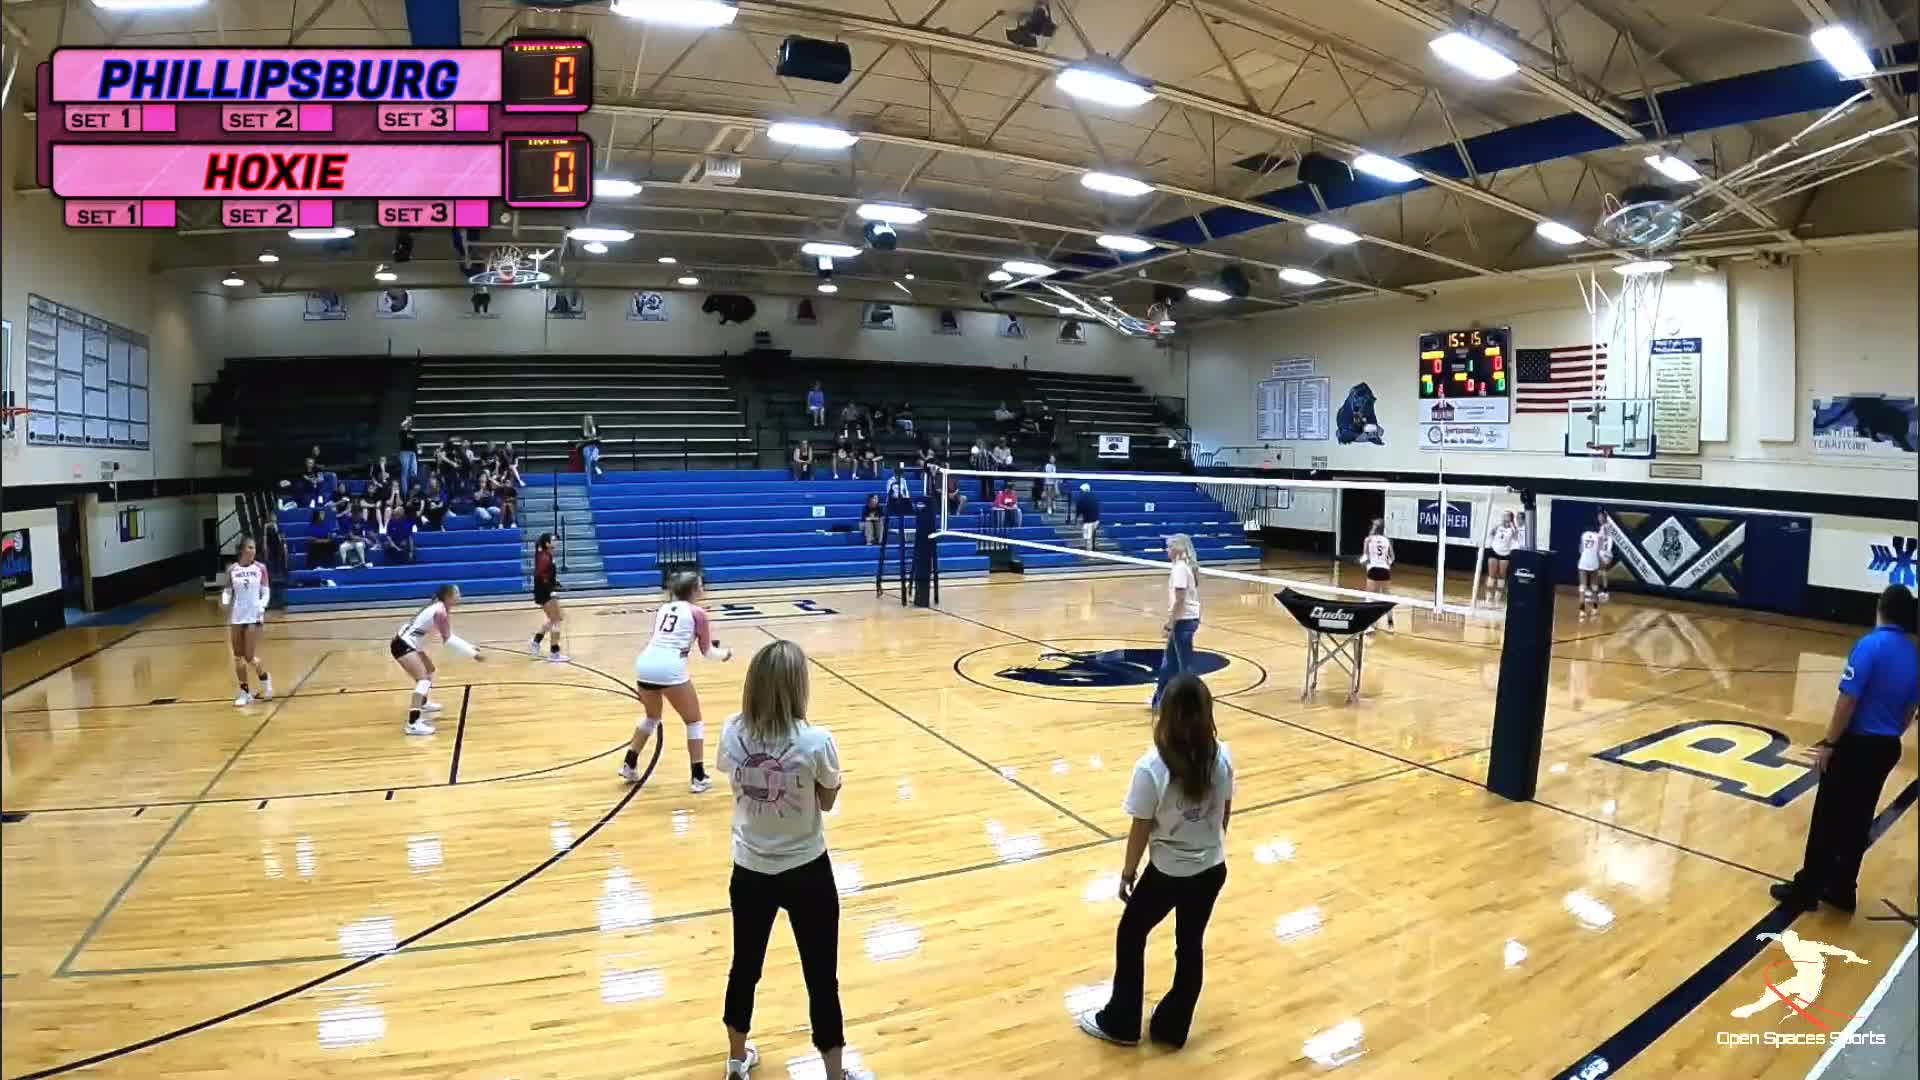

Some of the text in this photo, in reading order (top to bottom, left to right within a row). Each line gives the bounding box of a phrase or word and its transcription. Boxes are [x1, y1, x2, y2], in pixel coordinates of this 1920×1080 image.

[1419, 512, 1468, 528] PANHER
[1310, 606, 1354, 620] Baden
[659, 613, 678, 632] 13
